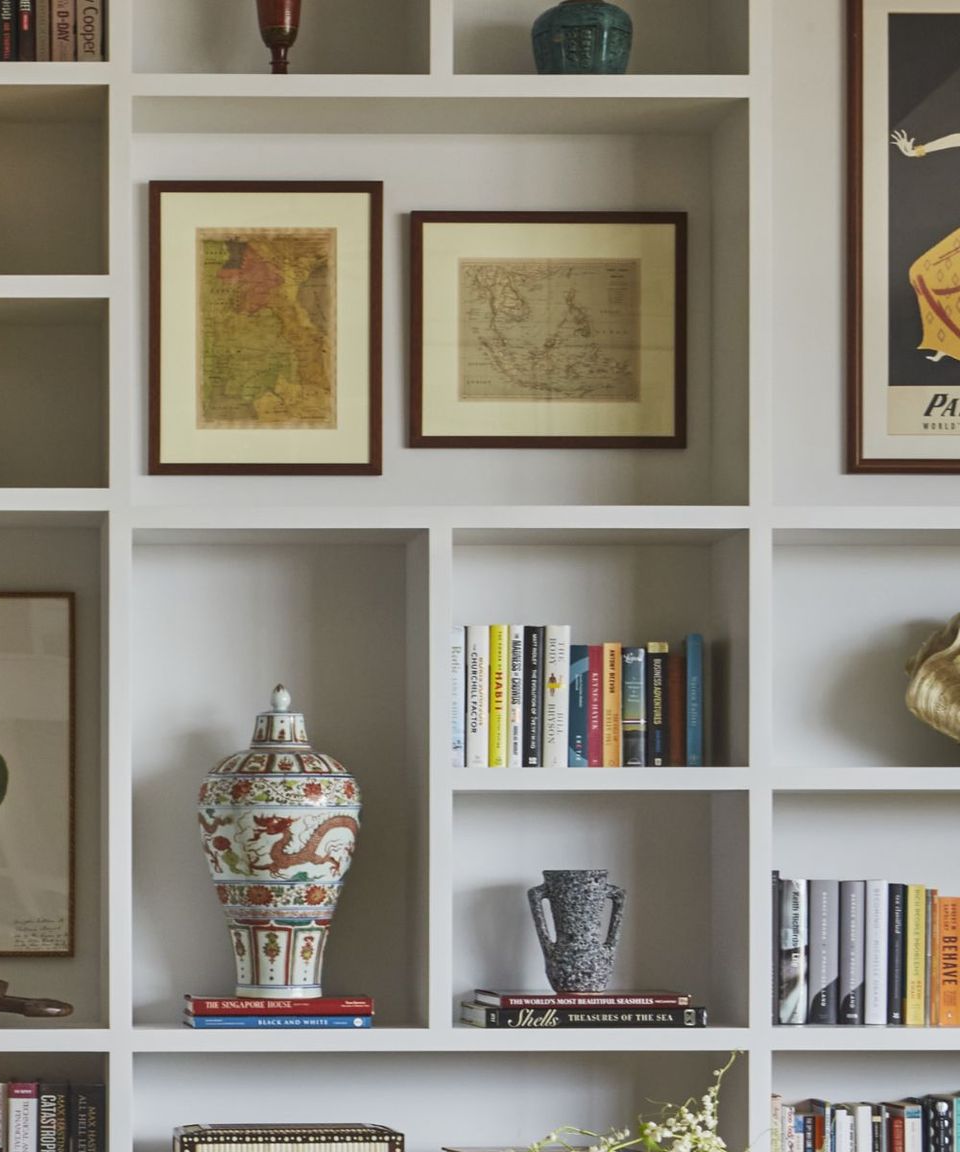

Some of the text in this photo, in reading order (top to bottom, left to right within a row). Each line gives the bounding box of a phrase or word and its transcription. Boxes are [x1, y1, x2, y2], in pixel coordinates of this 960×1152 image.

[57, 11, 70, 41] D-DAY
[80, 7, 98, 55] Cooper
[923, 393, 960, 416] PA
[511, 640, 521, 704] MADNESS CROWDS
[653, 659, 661, 724] BUSINESS ADVENTURES
[792, 891, 800, 947] Keith Richards
[942, 936, 957, 985] BEHAVE
[206, 1000, 292, 1009] THE SINGAPORE HOUSE
[507, 1009, 560, 1027] Shells
[568, 1014, 674, 1022] TREASURES OF THE SEA
[88, 1106, 96, 1127] MAX
